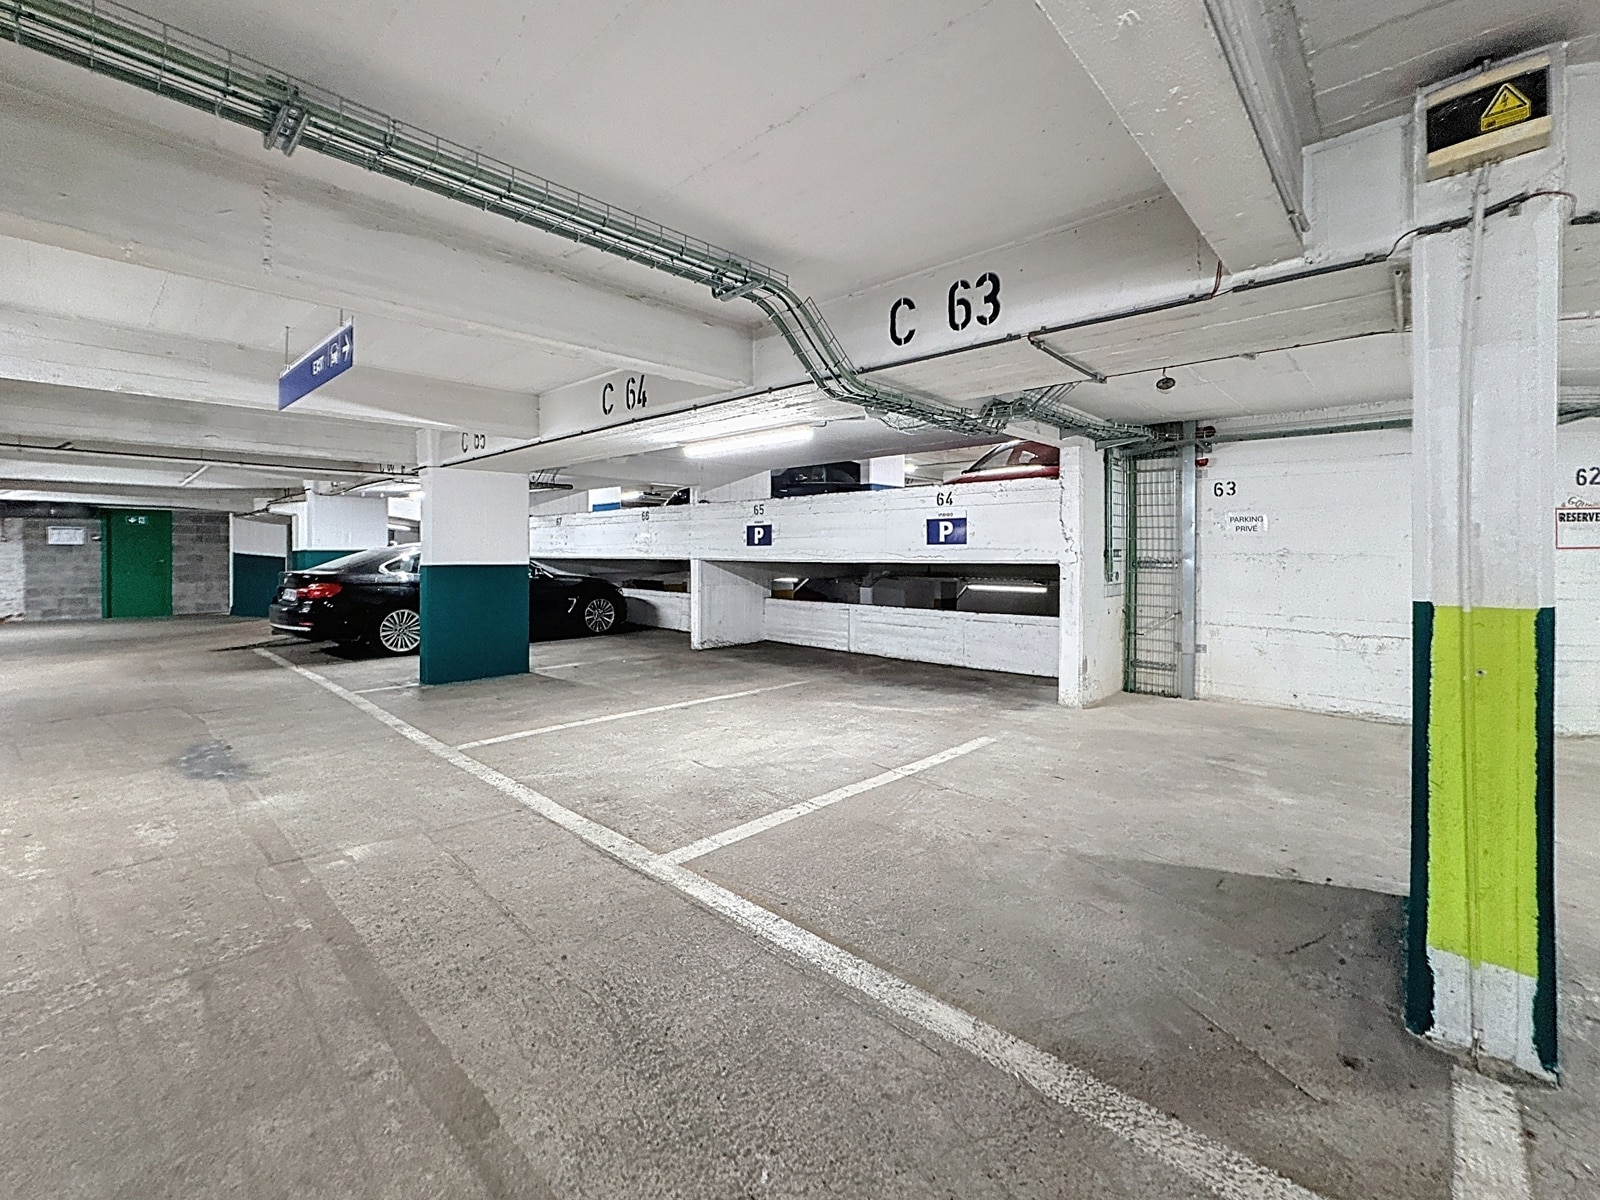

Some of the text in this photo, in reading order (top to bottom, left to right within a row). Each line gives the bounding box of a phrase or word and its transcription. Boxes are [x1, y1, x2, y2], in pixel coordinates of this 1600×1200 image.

[890, 272, 1001, 346] C 63
[602, 374, 647, 415] C 64
[461, 432, 469, 453] C
[1576, 466, 1600, 486] 62
[1213, 480, 1237, 497] 63
[936, 491, 953, 506] 64
[753, 503, 765, 516] 65
[1229, 515, 1264, 523] PARKING
[754, 527, 765, 545] P
[938, 520, 954, 543] P
[1235, 524, 1258, 533] PRIVÉ
